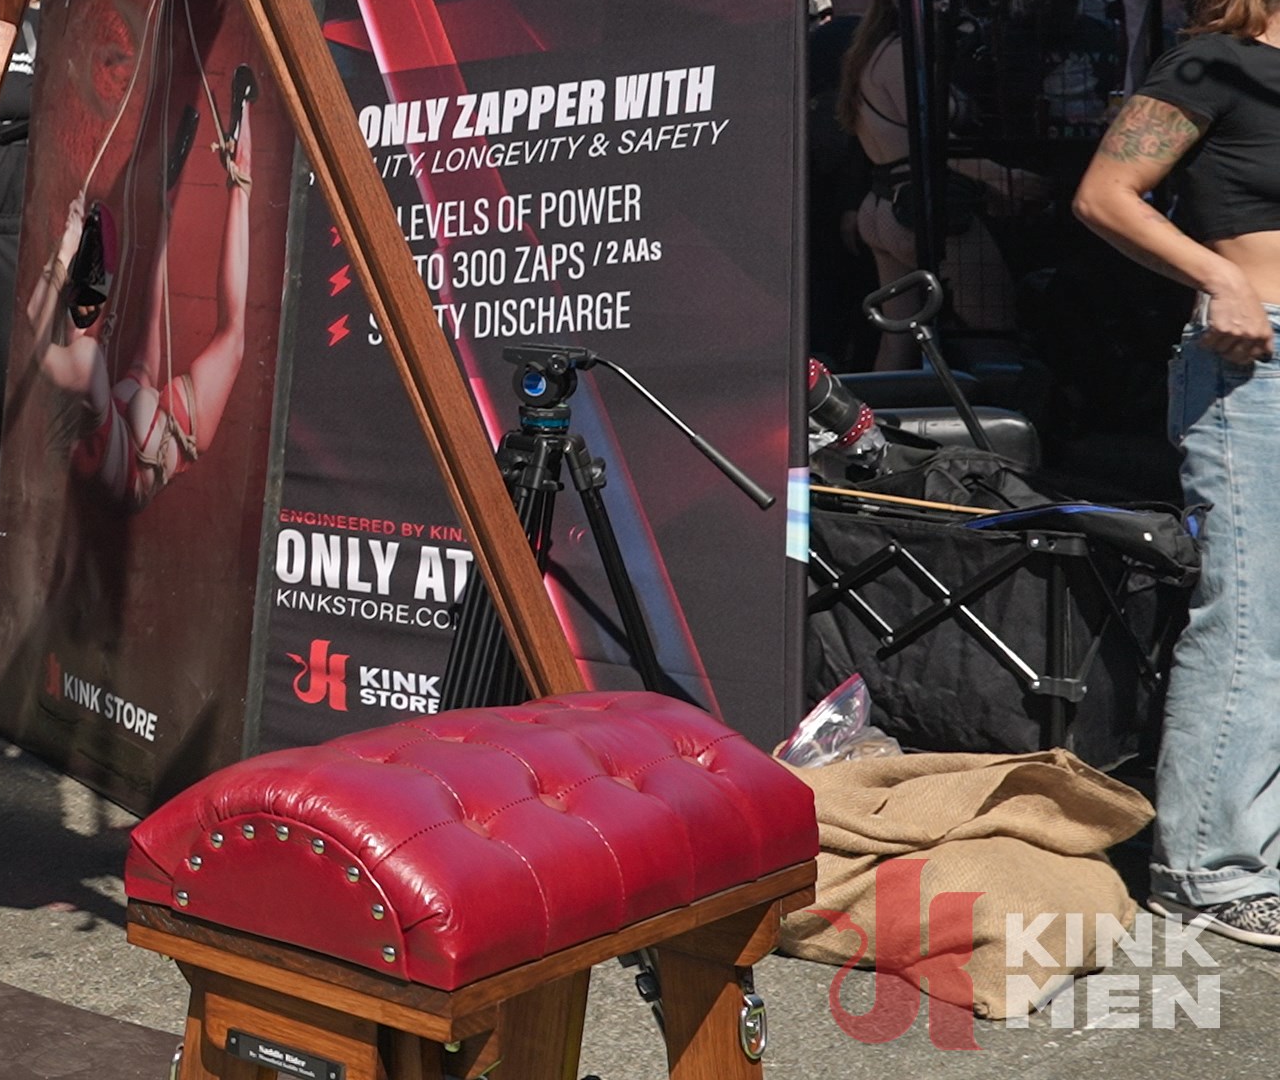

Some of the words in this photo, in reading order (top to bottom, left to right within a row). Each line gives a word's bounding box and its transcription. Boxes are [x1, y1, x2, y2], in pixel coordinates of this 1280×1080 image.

[357, 96, 449, 149] ONLY
[451, 78, 608, 140] ZAPPER
[614, 64, 716, 121] WITH
[430, 133, 586, 174] LONGEVITY
[588, 132, 610, 158] &
[616, 119, 730, 153] SAFETY
[397, 196, 490, 242] LEVELS
[498, 193, 533, 233] OF
[540, 183, 642, 230] POWER
[452, 248, 506, 289] 300
[513, 241, 585, 284] ZAPS
[605, 241, 619, 265] 2
[622, 237, 663, 264] AAs
[474, 290, 632, 340] DISCHARGE
[279, 508, 396, 536] ENGINEERED
[401, 522, 425, 538] BY
[429, 525, 468, 544] KIN
[275, 528, 400, 596] ONLY
[413, 546, 474, 604] AT
[63, 671, 102, 714] KINK
[104, 692, 158, 742] STORE
[359, 665, 441, 698] KINK
[359, 688, 440, 715] STORE
